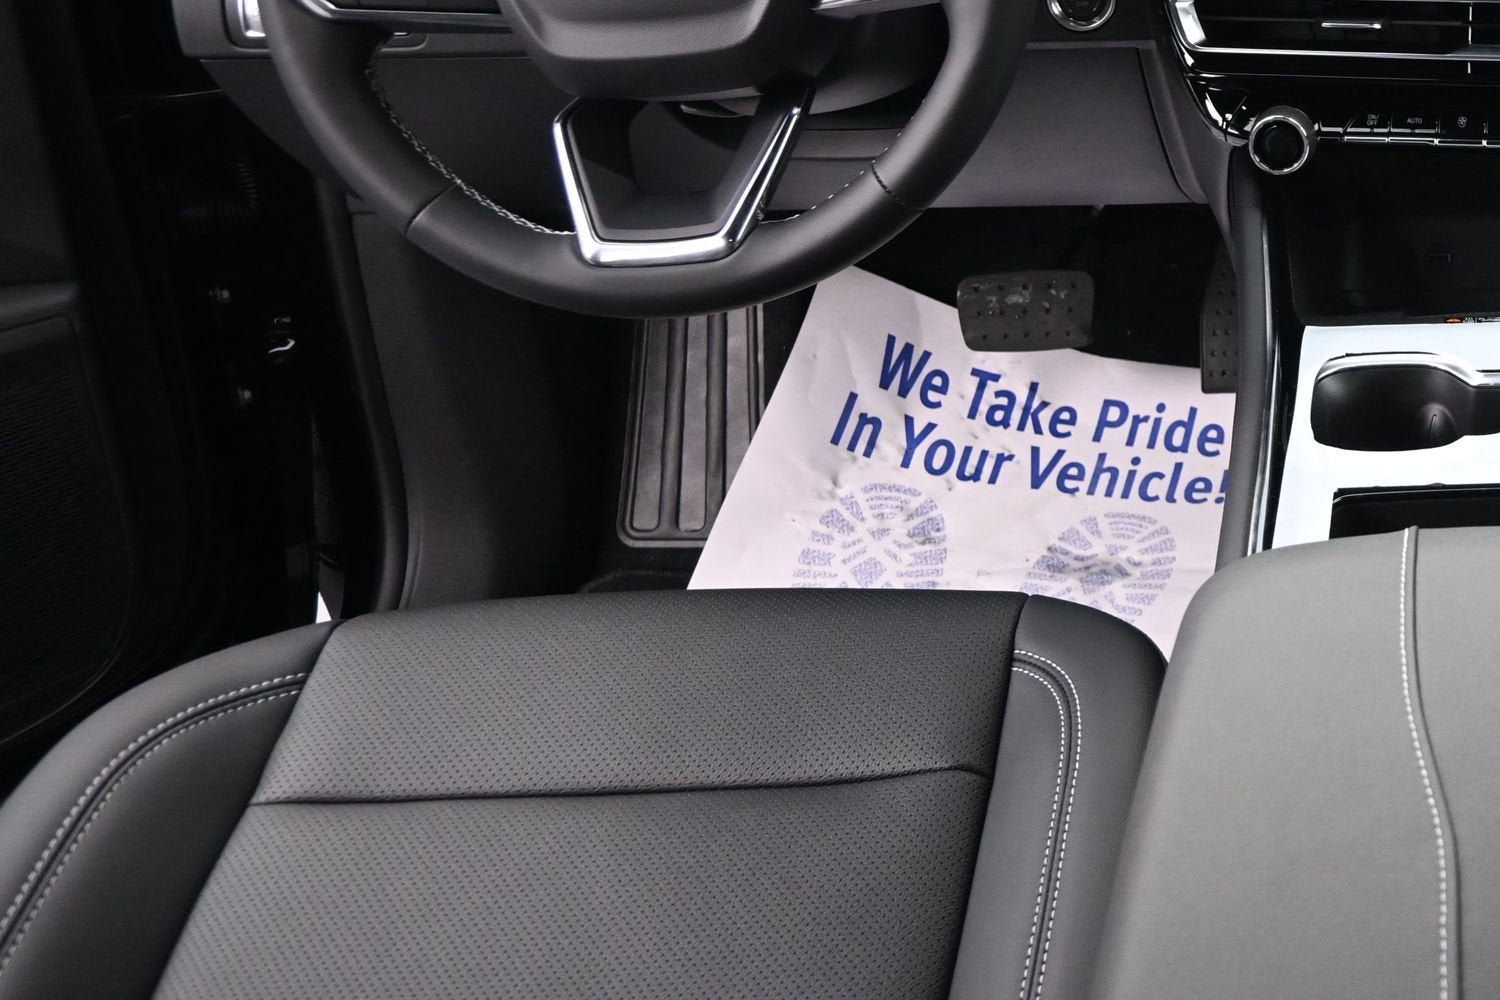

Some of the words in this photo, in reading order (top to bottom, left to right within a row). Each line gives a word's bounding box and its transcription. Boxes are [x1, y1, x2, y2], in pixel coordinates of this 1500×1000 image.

[829, 391, 883, 459] In
[900, 415, 1015, 485] Your
[1029, 445, 1229, 505] Vehicle!
[878, 333, 951, 409] We
[966, 367, 1078, 440] Take
[1092, 398, 1226, 457] Pride
